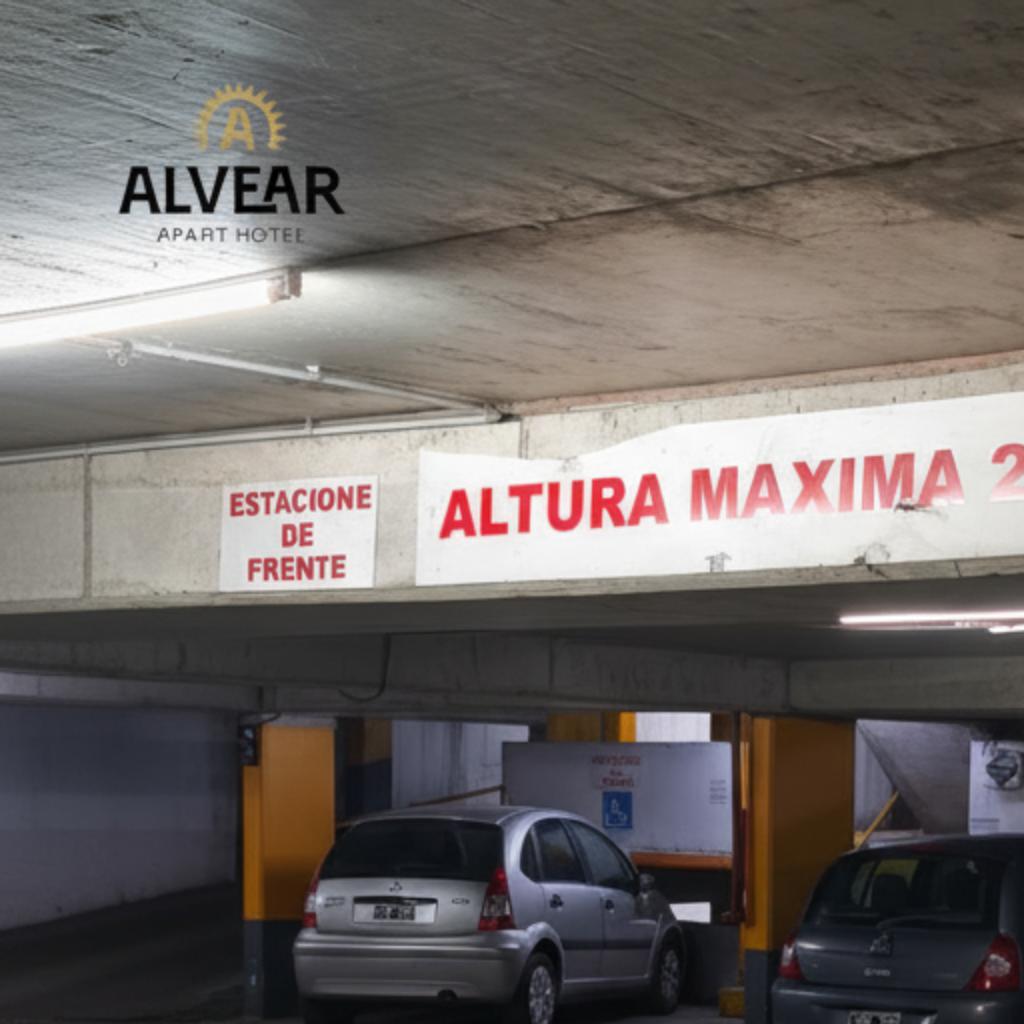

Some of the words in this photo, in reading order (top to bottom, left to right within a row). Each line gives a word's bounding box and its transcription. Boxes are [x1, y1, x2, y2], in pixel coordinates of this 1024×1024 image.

[229, 484, 373, 518] ESTACIONE
[438, 472, 669, 540] ALTURA
[689, 448, 965, 522] MAXIMA
[281, 522, 314, 548] DE
[247, 554, 347, 582] FRENTE
